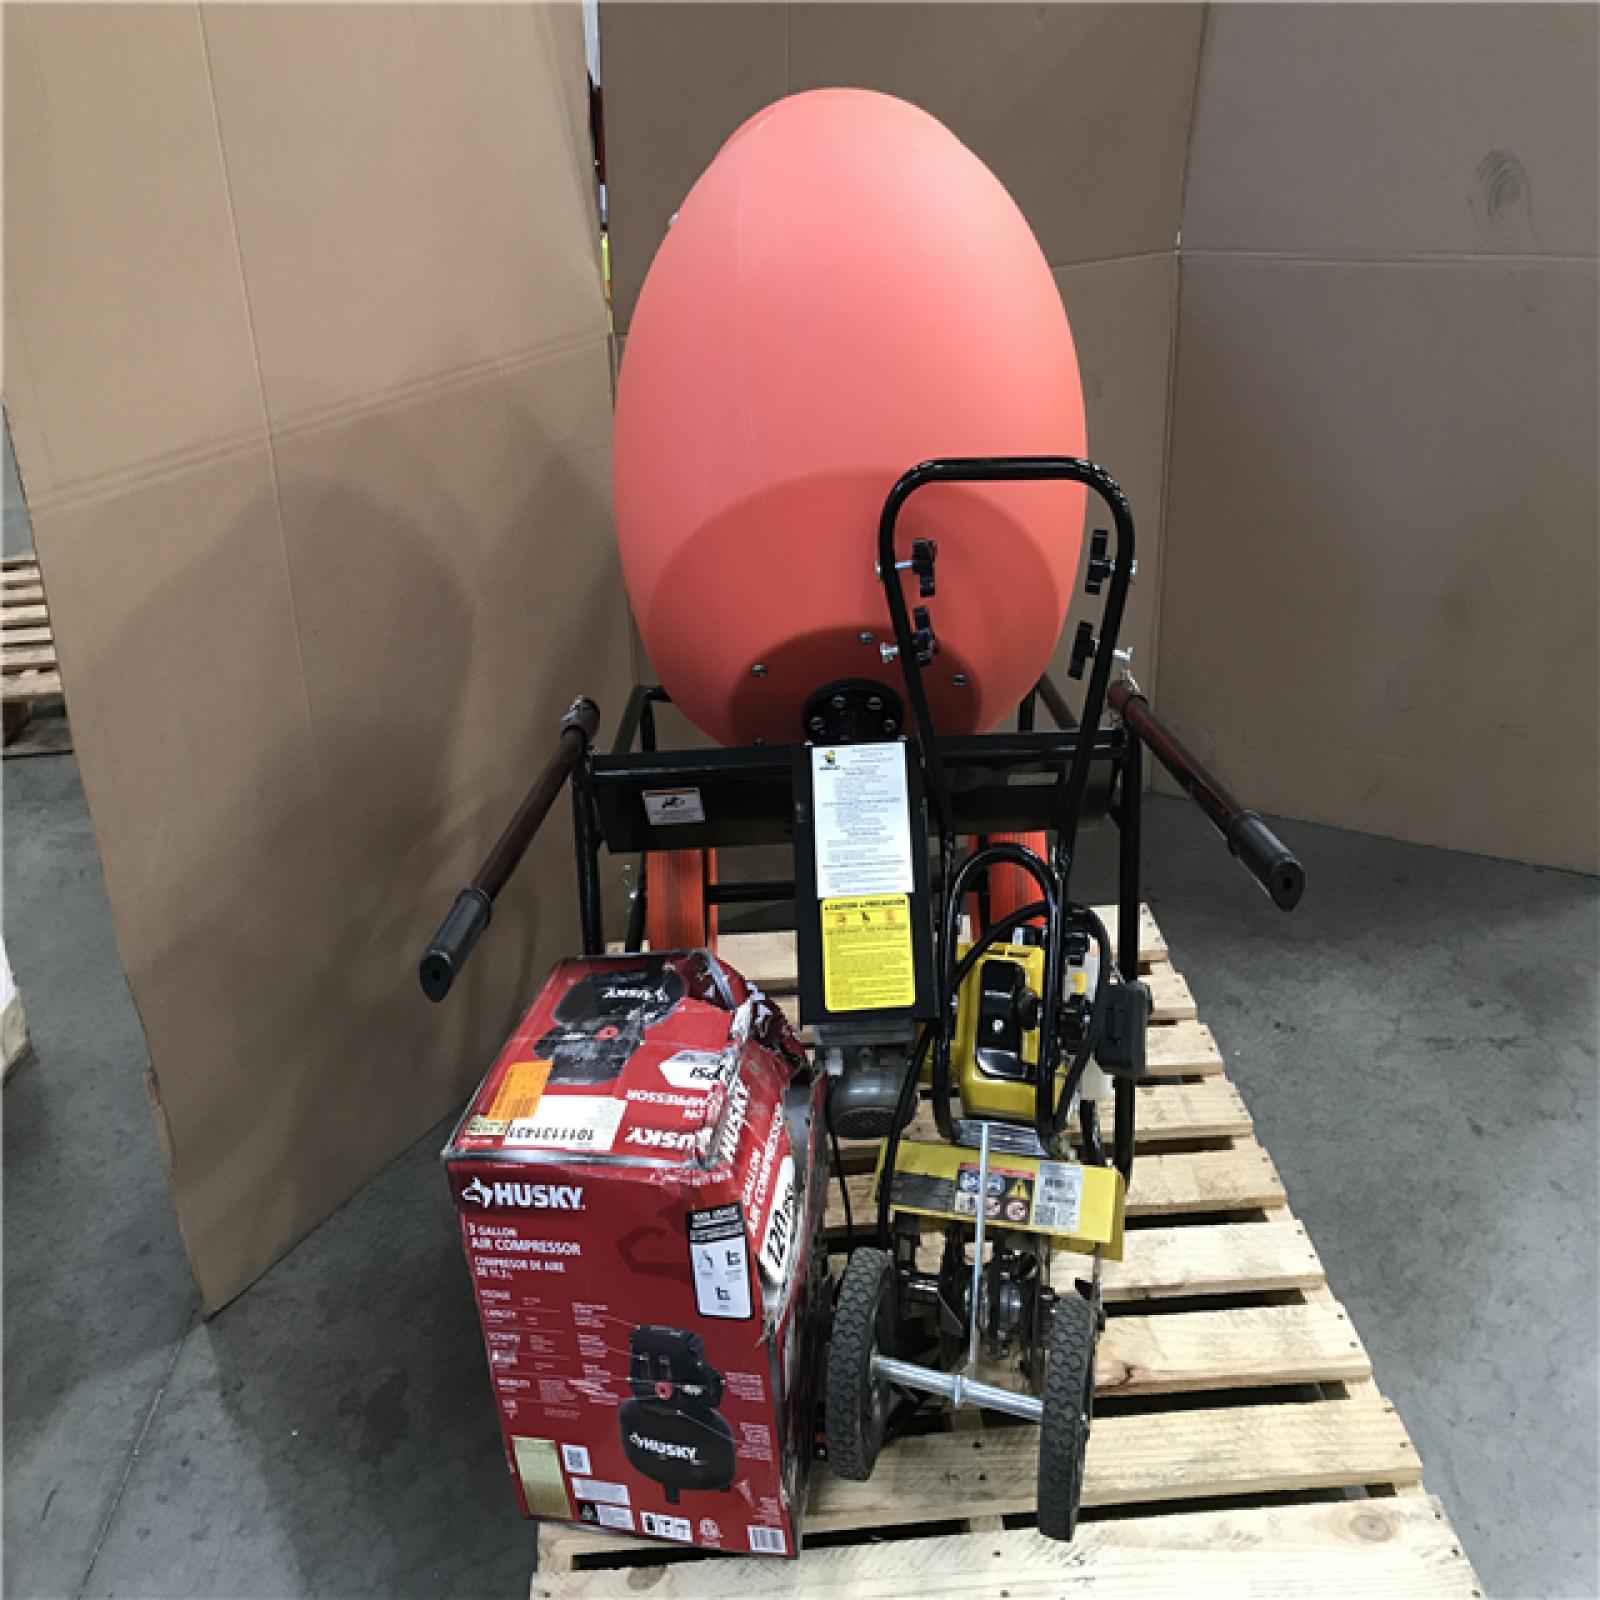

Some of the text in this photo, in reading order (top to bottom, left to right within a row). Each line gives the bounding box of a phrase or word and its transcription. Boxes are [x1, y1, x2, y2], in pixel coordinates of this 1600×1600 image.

[493, 1182, 584, 1210] HUSKY
[478, 1226, 518, 1237] GALLON
[471, 1237, 581, 1256] AIR COMPRESSOR
[642, 1439, 698, 1460] HUSKY
